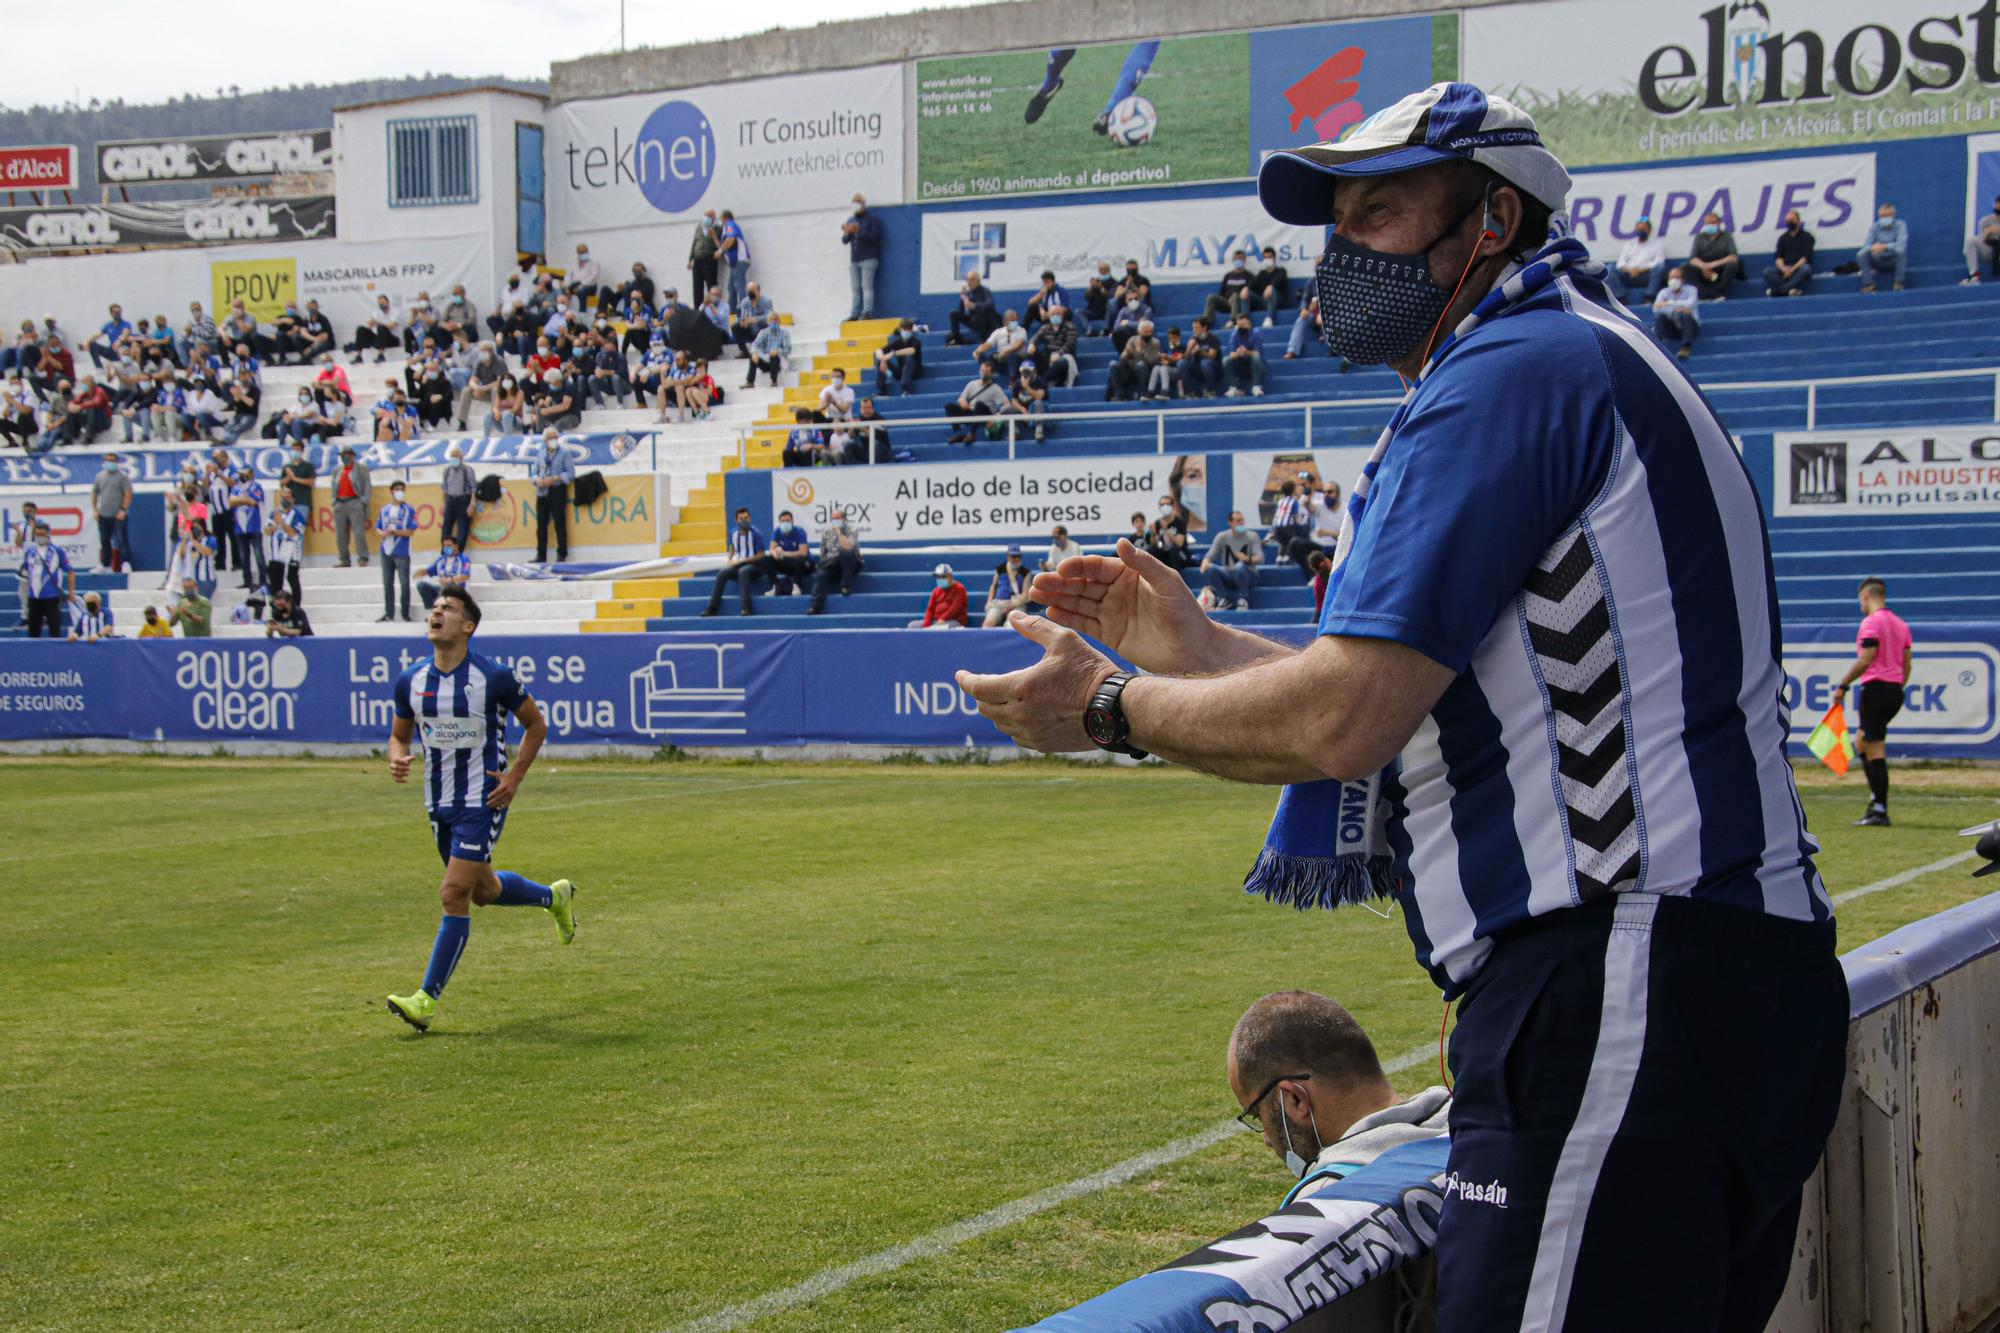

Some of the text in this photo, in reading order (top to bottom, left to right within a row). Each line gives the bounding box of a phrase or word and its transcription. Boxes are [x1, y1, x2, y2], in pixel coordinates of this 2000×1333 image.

[922, 74, 992, 89] www.enrile.eu
[922, 105, 941, 117] 965
[1638, 128, 1654, 151] el
[1734, 120, 1755, 142] de
[1853, 109, 1873, 131] El
[1877, 105, 1947, 129] Comtat
[1966, 101, 1984, 121] la
[739, 110, 882, 146] IT Consulting
[103, 144, 197, 181] CEROL
[565, 120, 708, 190] teknei
[738, 147, 884, 179] www.teknei.com
[923, 165, 1170, 196] Desde 1960 animando al deportivo!
[26, 204, 279, 245] CEROL CEROL
[1571, 179, 1857, 241] RUPAJES
[1147, 233, 1265, 269] MAYA
[303, 263, 435, 282] MASCARILLAS FFP2
[112, 432, 591, 484] BLANQUAZULES
[895, 470, 1154, 499] Al lado de la sociedad
[1858, 470, 1888, 488] LA
[522, 495, 648, 527] NTURA
[895, 504, 1101, 530] y de las empresas
[0, 669, 83, 688] ORREDURÍA
[175, 650, 270, 692] aqua
[350, 648, 389, 683] La
[547, 655, 586, 683] se
[0, 695, 85, 711] E SEGUROS
[193, 691, 296, 730] clean
